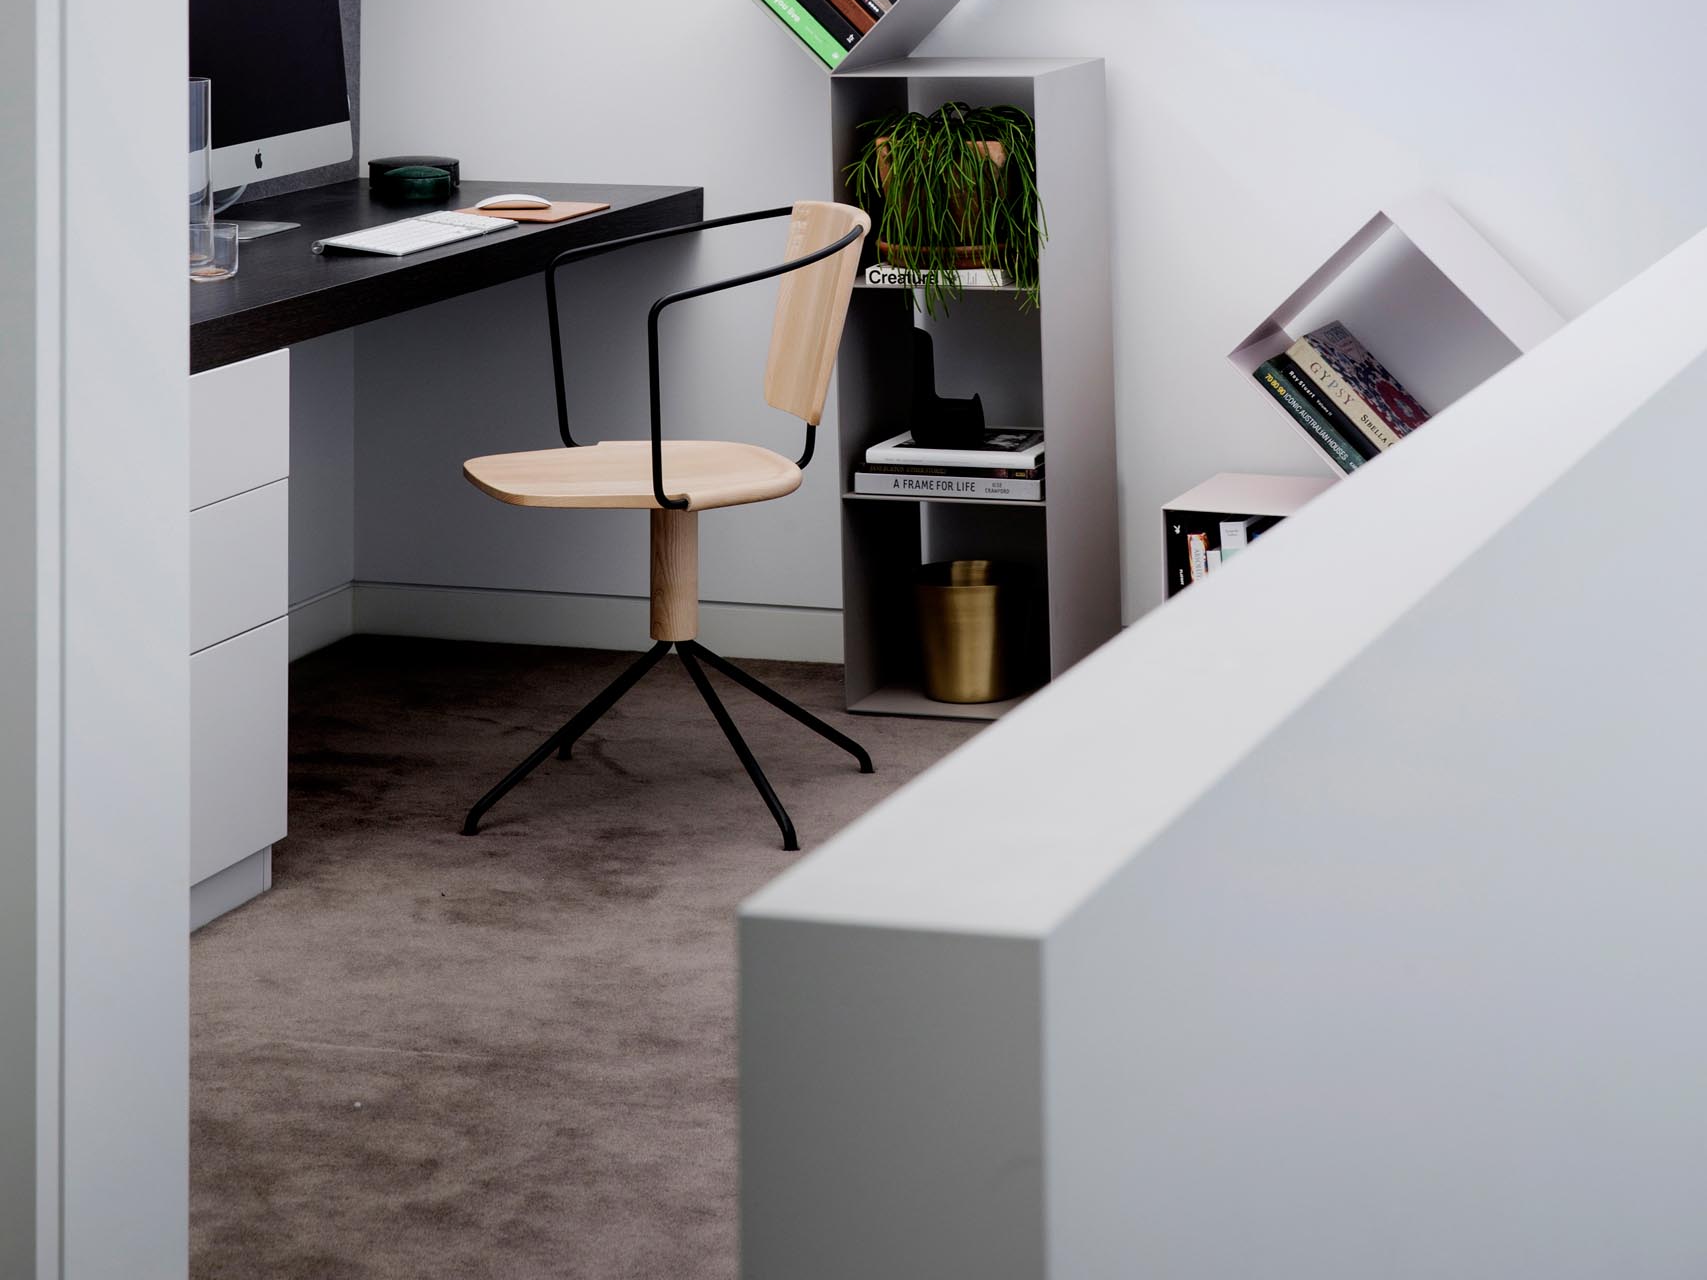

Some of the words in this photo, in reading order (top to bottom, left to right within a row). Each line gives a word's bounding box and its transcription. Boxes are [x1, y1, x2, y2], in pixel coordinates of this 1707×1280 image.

[786, 7, 801, 22] live
[1298, 380, 1316, 399] Stuart
[1310, 361, 1355, 405] GYPSY
[1360, 414, 1388, 444] SIBELLA
[1265, 372, 1273, 383] 70
[1277, 386, 1287, 396] 90
[1283, 392, 1303, 412] ICONIC
[1298, 409, 1330, 441] AUSTRALIAN
[1326, 438, 1349, 460] HOUSES
[893, 479, 900, 489] A
[903, 479, 934, 490] FRAME
[936, 481, 954, 491] FOR
[956, 481, 976, 492] LIFE
